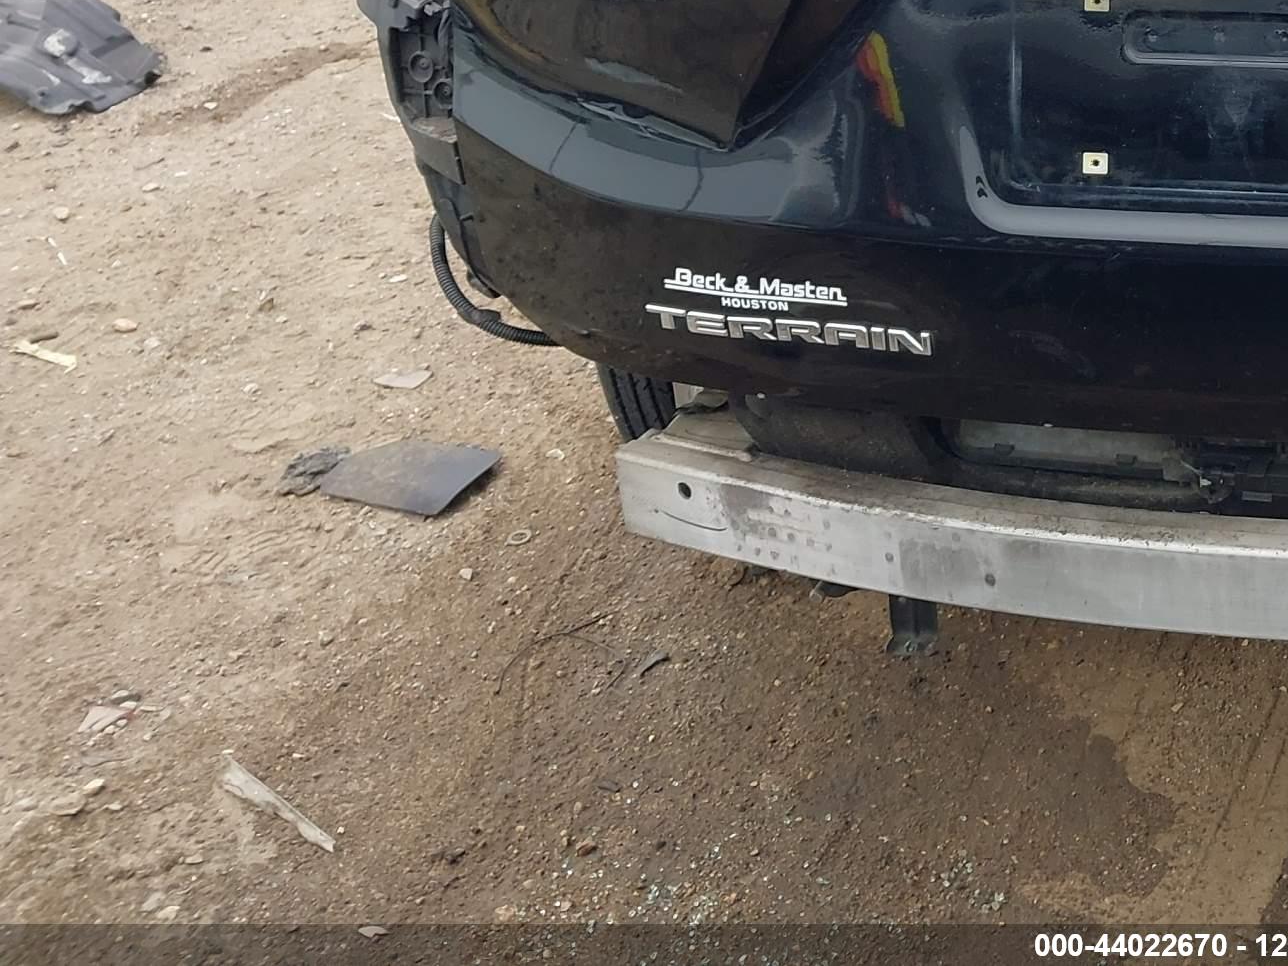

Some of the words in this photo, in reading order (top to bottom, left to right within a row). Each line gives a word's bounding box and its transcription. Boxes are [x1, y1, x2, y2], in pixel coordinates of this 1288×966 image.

[668, 267, 733, 291] Beck
[734, 275, 752, 293] &
[759, 277, 847, 301] Masten
[721, 296, 789, 311] HOUSTON
[645, 303, 933, 356] TERRAIN
